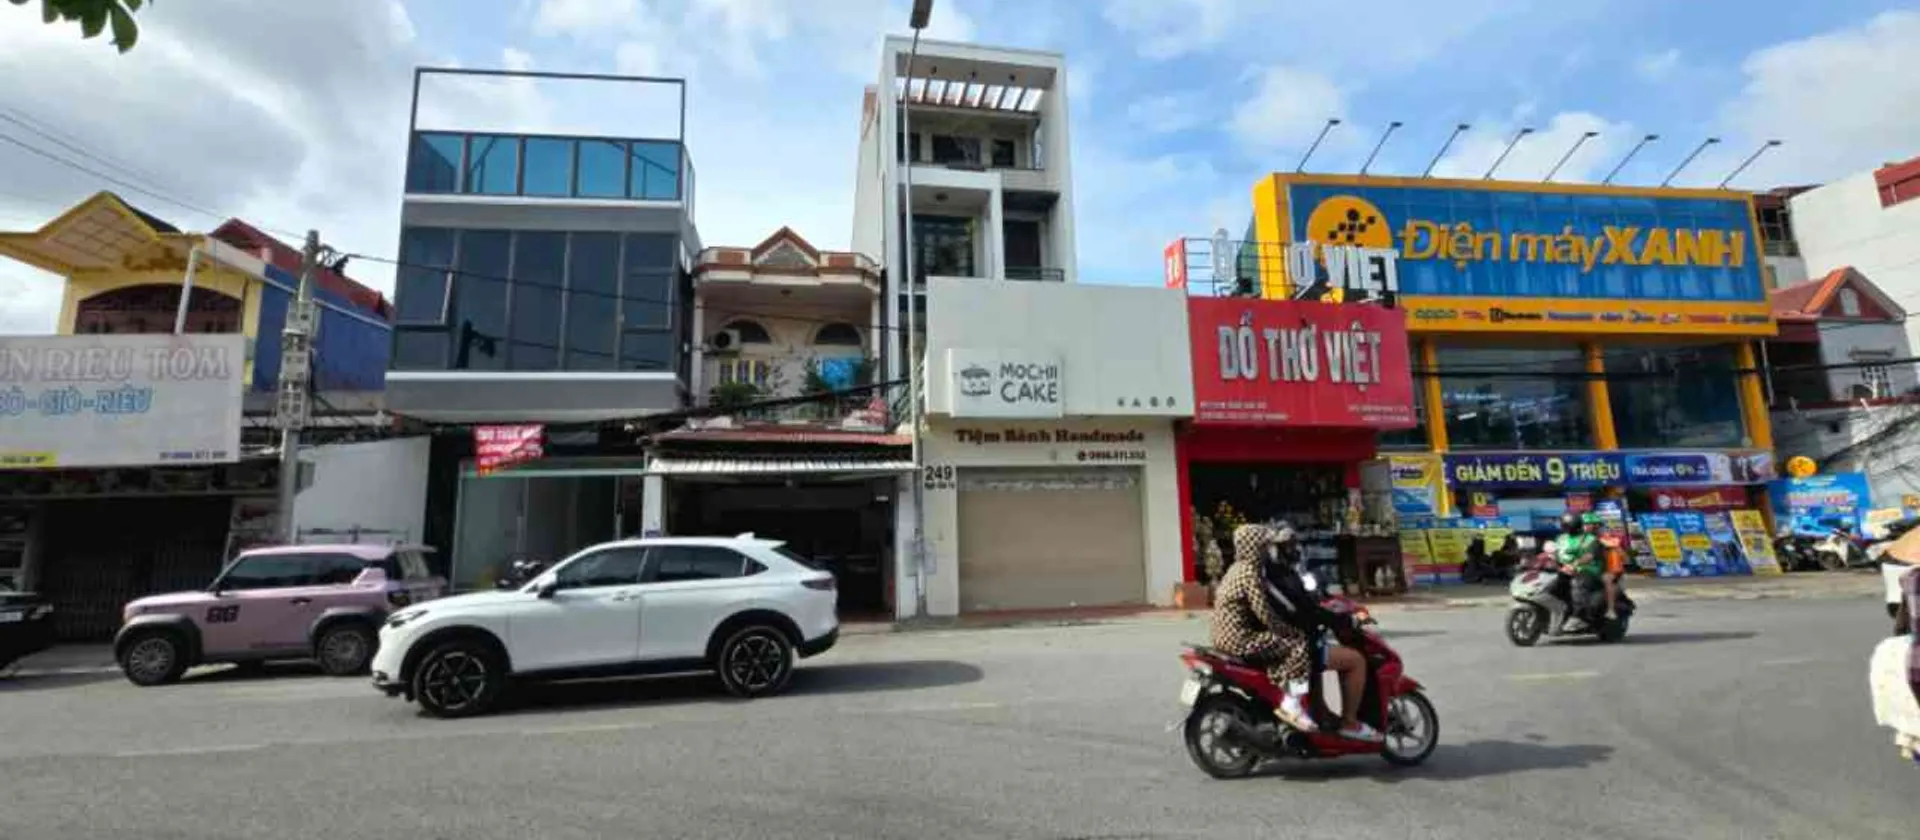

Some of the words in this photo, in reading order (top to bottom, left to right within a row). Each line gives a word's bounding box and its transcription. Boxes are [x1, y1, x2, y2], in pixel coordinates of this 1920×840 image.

[1398, 219, 1502, 271] Điện
[1323, 319, 1382, 392] VIỆT
[1000, 362, 1057, 380] MOCHII
[1000, 381, 1058, 403] CAKE
[954, 427, 1000, 446] Tiệm
[925, 465, 953, 481] 249
[1455, 457, 1501, 481] GIẢM
[1504, 456, 1543, 481] ĐẾN
[1546, 457, 1566, 484] 9
[1569, 458, 1620, 484] TRIỆU
